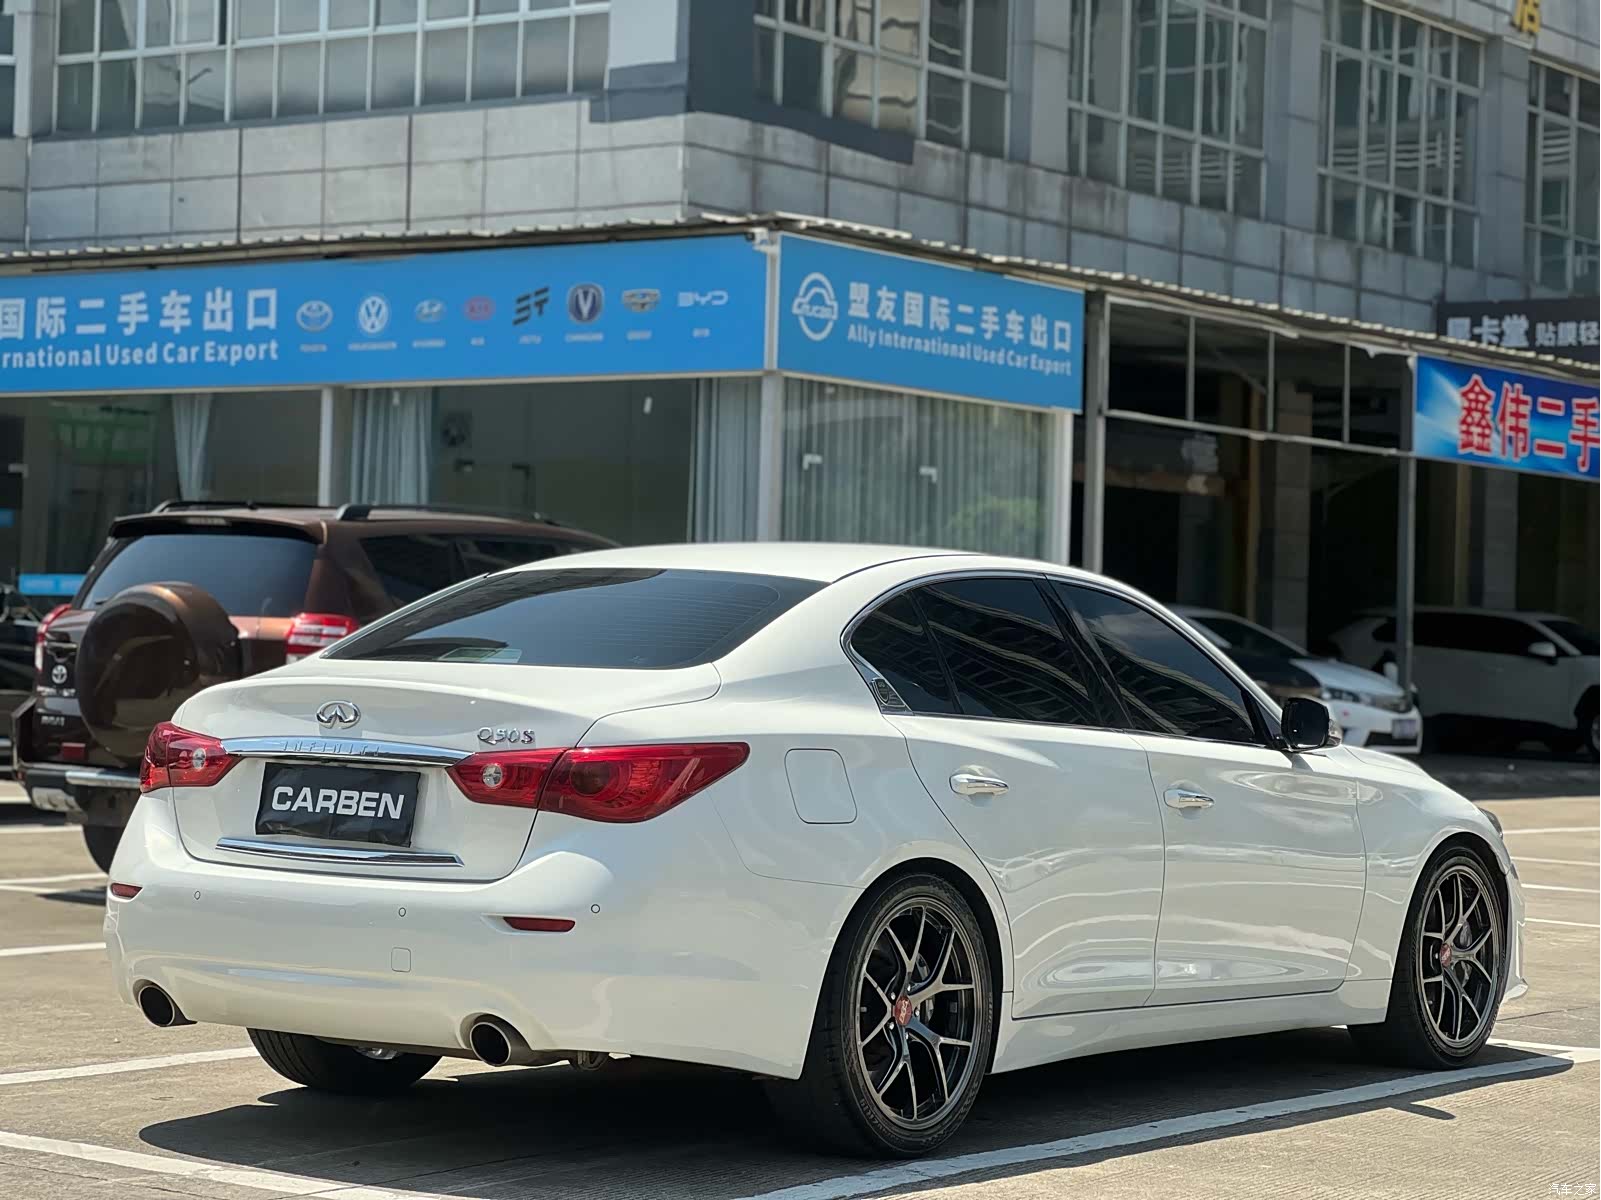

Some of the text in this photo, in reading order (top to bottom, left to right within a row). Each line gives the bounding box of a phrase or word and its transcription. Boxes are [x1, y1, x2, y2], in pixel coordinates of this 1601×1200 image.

[0, 286, 278, 340] 国际二手车出口
[847, 282, 1072, 353] 盟友国际二手车出口
[2, 339, 278, 368] rnational Used Car Export
[847, 323, 1072, 376] Ally International Used Car Export
[1457, 374, 1600, 472] 鑫伟二手
[283, 741, 380, 757] INFINITI
[477, 726, 536, 746] Q50S
[271, 786, 405, 820] CARBEN
